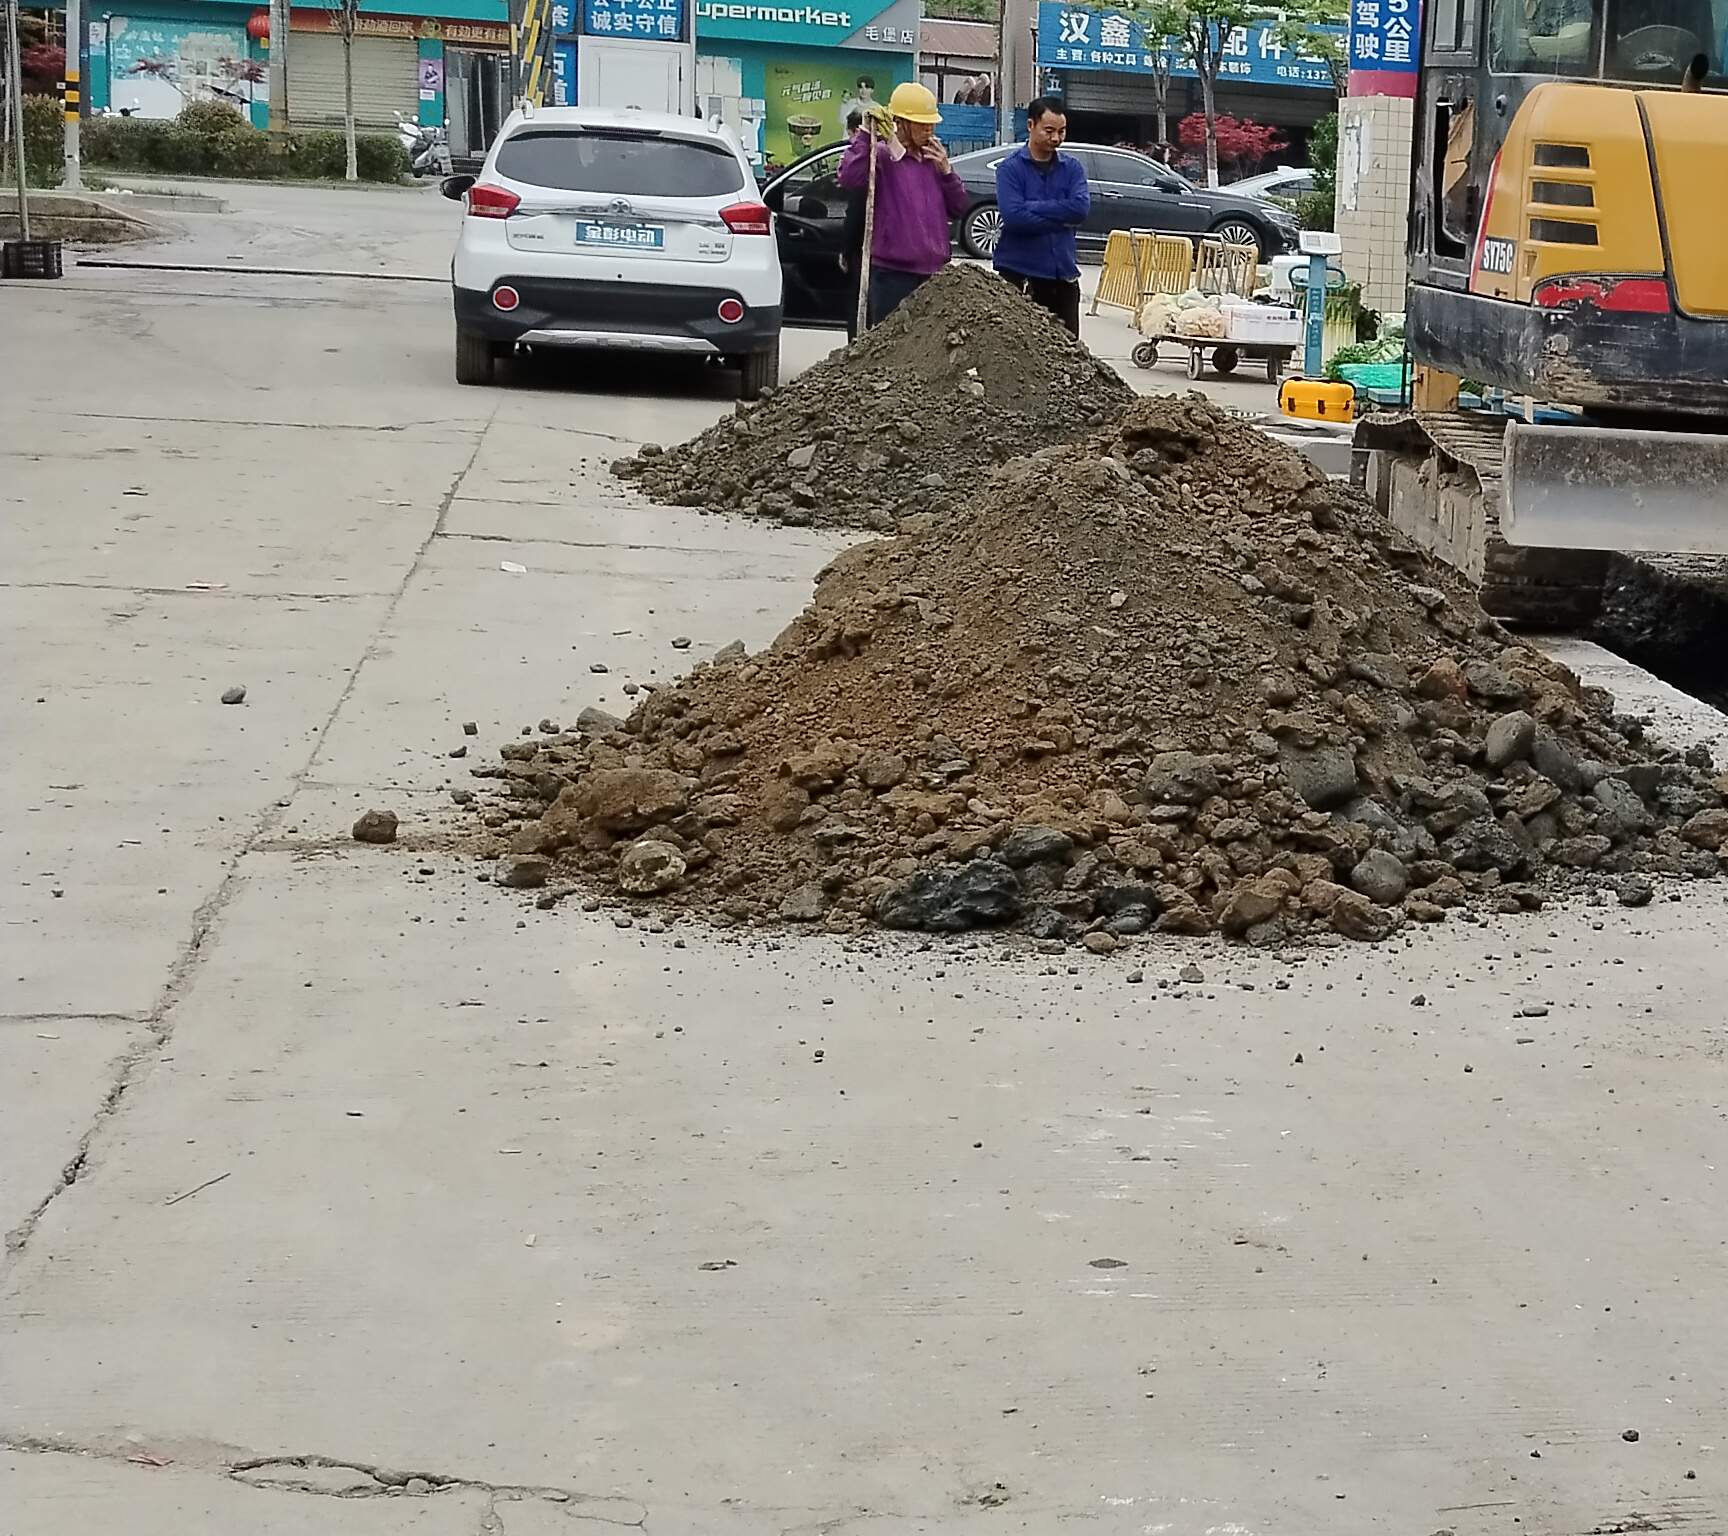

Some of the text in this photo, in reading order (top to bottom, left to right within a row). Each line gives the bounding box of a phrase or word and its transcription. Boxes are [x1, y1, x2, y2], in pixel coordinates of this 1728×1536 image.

[591, 10, 677, 35] 诚实守信
[865, 25, 915, 45] 毛堡店
[1483, 239, 1514, 273] SY75C
